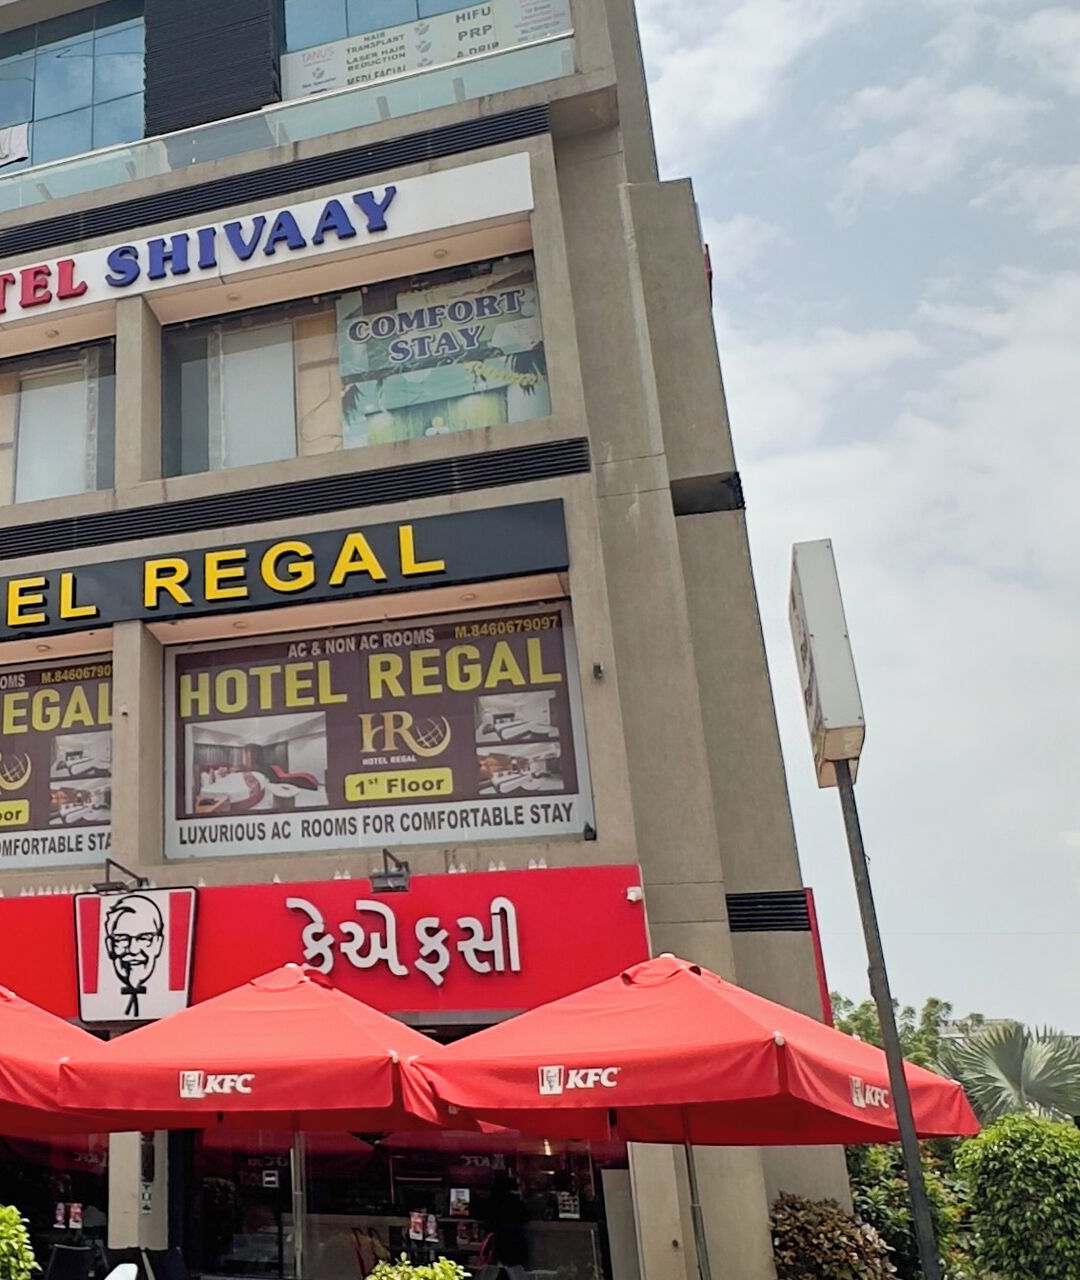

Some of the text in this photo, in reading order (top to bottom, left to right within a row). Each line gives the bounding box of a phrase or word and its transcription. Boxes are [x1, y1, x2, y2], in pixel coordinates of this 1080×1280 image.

[455, 6, 491, 24] HIFU
[346, 34, 405, 54] TRANSPLANT
[363, 31, 386, 42] HAIR
[458, 24, 492, 41] PRP
[346, 45, 406, 64] LASER HAIR
[347, 52, 406, 72] REDUCTION
[105, 185, 397, 289] SHIVAAY
[347, 289, 525, 343] COMFORT
[388, 325, 485, 363] STAY
[143, 524, 446, 608] REGAL
[454, 616, 558, 640] M.8460679097
[288, 628, 435, 659] AC & NON AC ROOMS
[179, 637, 562, 718] HOTEL REGAL
[362, 754, 417, 766] HOTEL REGAL
[355, 775, 445, 797] 1st Floor
[179, 801, 573, 846] LUXURIOUS AC ROOMS FOR COMFORTABLE STAY
[286, 896, 521, 986] કેએફસી
[204, 1073, 256, 1094] KFC
[565, 1067, 619, 1089] KFC
[864, 1085, 890, 1109] KFC
